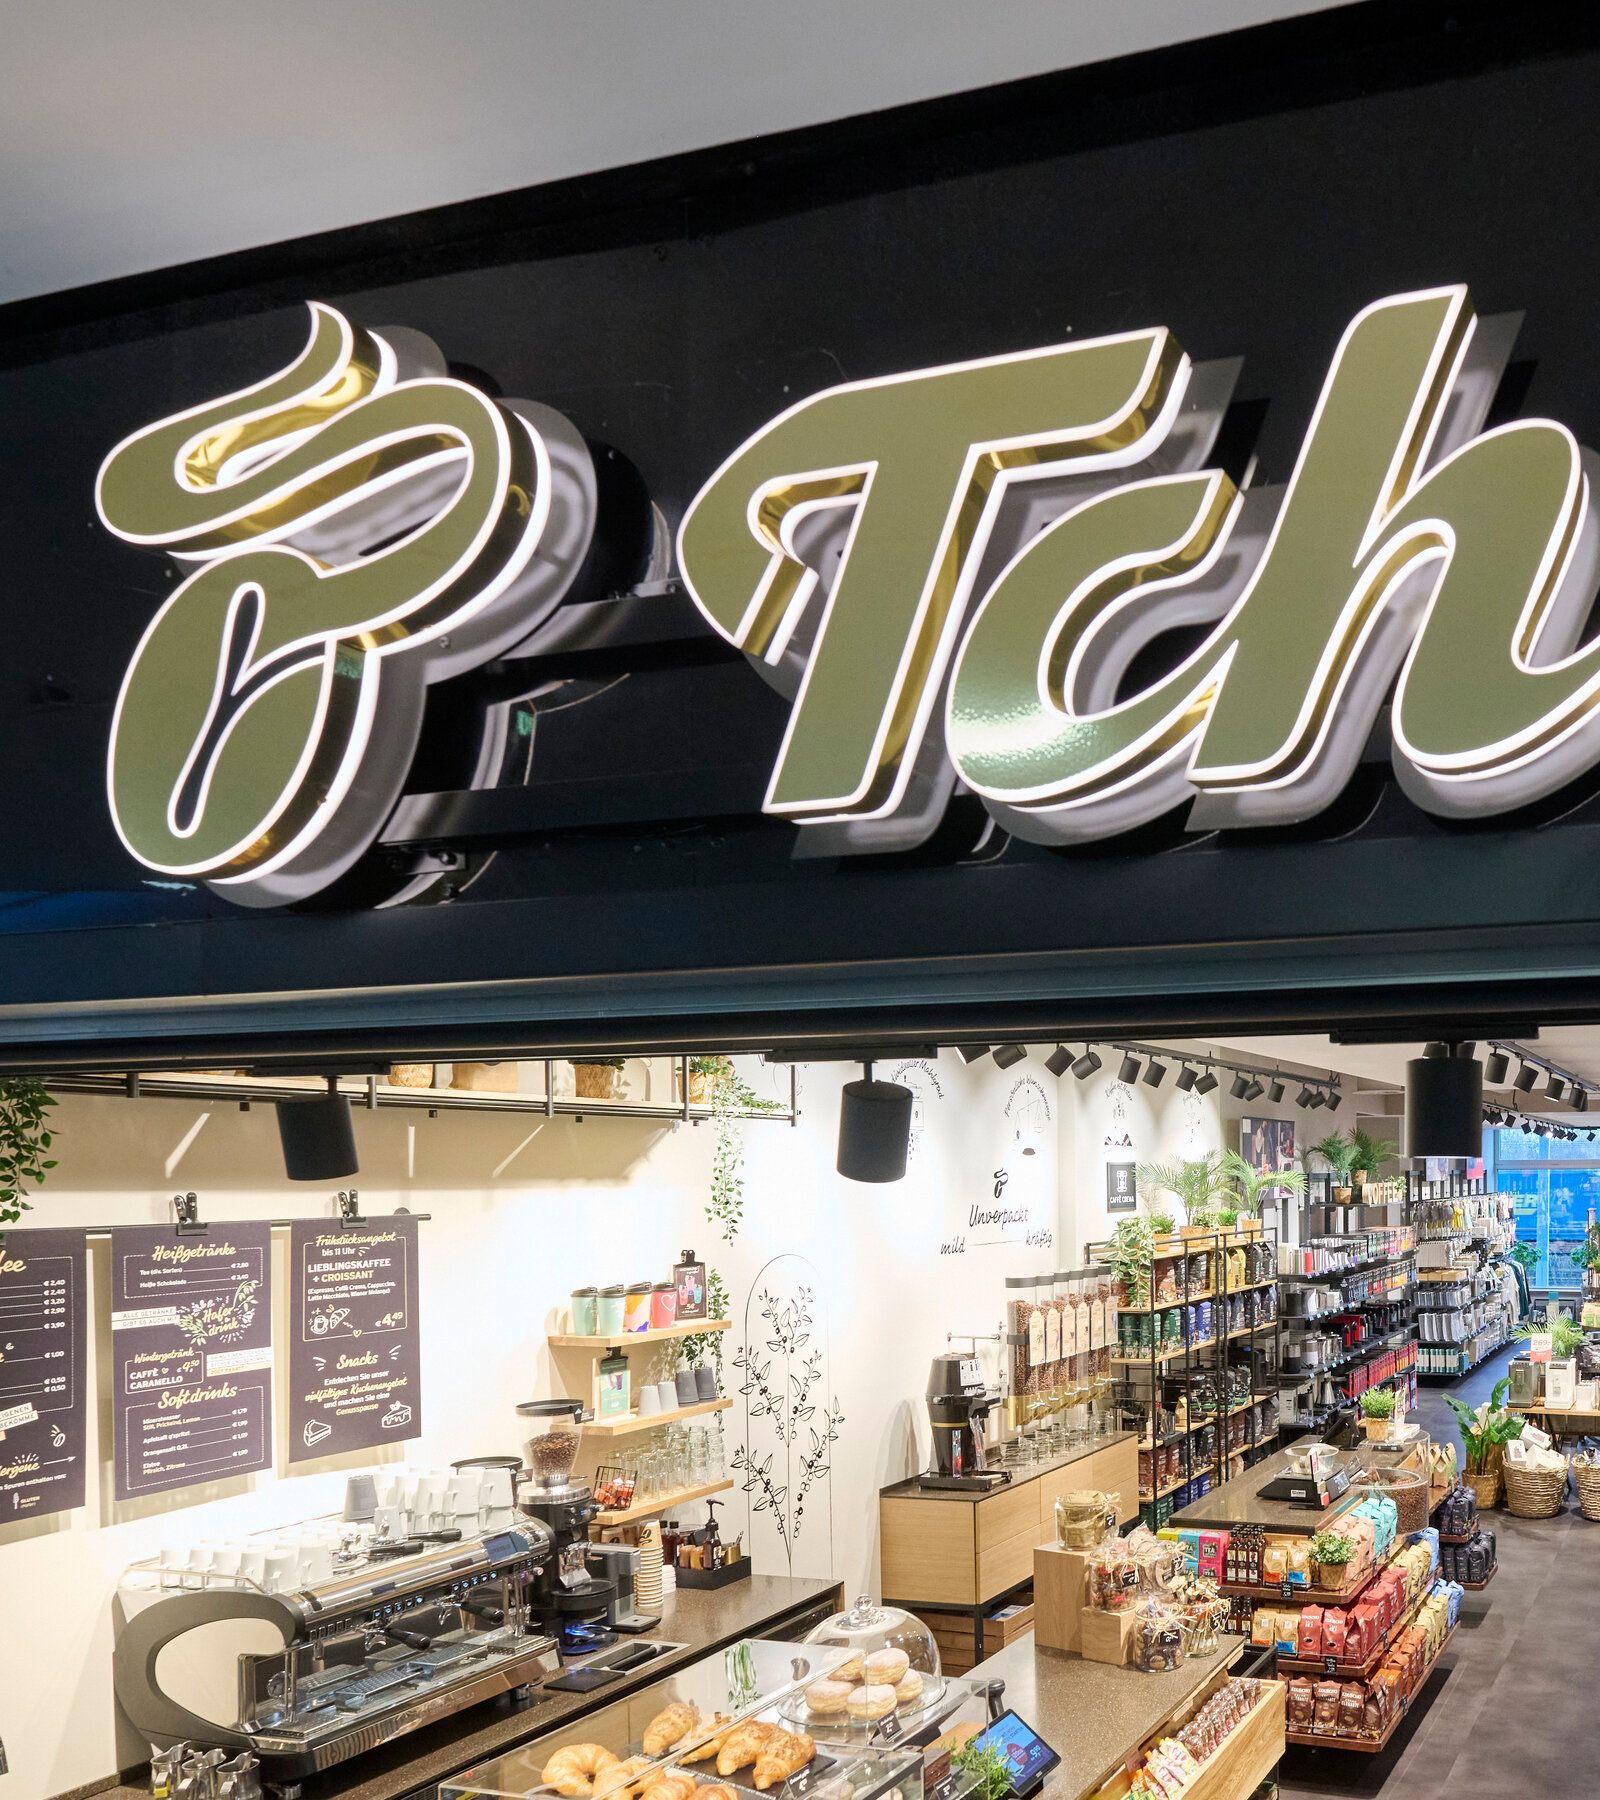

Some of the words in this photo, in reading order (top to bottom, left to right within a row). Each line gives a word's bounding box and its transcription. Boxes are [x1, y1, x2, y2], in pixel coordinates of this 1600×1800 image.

[969, 1204, 1029, 1230] Unverpackt
[316, 1232, 396, 1246] Frühstücksangebot
[940, 1235, 965, 1255] mild
[1026, 1230, 1052, 1248] kräftig
[152, 1242, 236, 1264] Heißgetränke
[322, 1248, 333, 1256] bis
[308, 1258, 391, 1272] LIEBLINGSKAFFEE
[321, 1270, 374, 1282] CROISSANT
[208, 1317, 240, 1336] drink
[134, 1347, 194, 1364] Wintergetränk
[336, 1351, 379, 1370] Snacks
[130, 1367, 158, 1380] CAFFÈ
[324, 1376, 359, 1386] Entdecken
[371, 1370, 389, 1378] unser
[130, 1376, 183, 1390] CARAMELLO
[305, 1388, 348, 1402] vielfältiges
[350, 1377, 408, 1394] Kuchenangebot
[158, 1382, 238, 1409] Softdrinks
[338, 1397, 364, 1406] machen
[336, 1404, 379, 1416] Genusspause
[4, 1480, 25, 1490] Spuren
